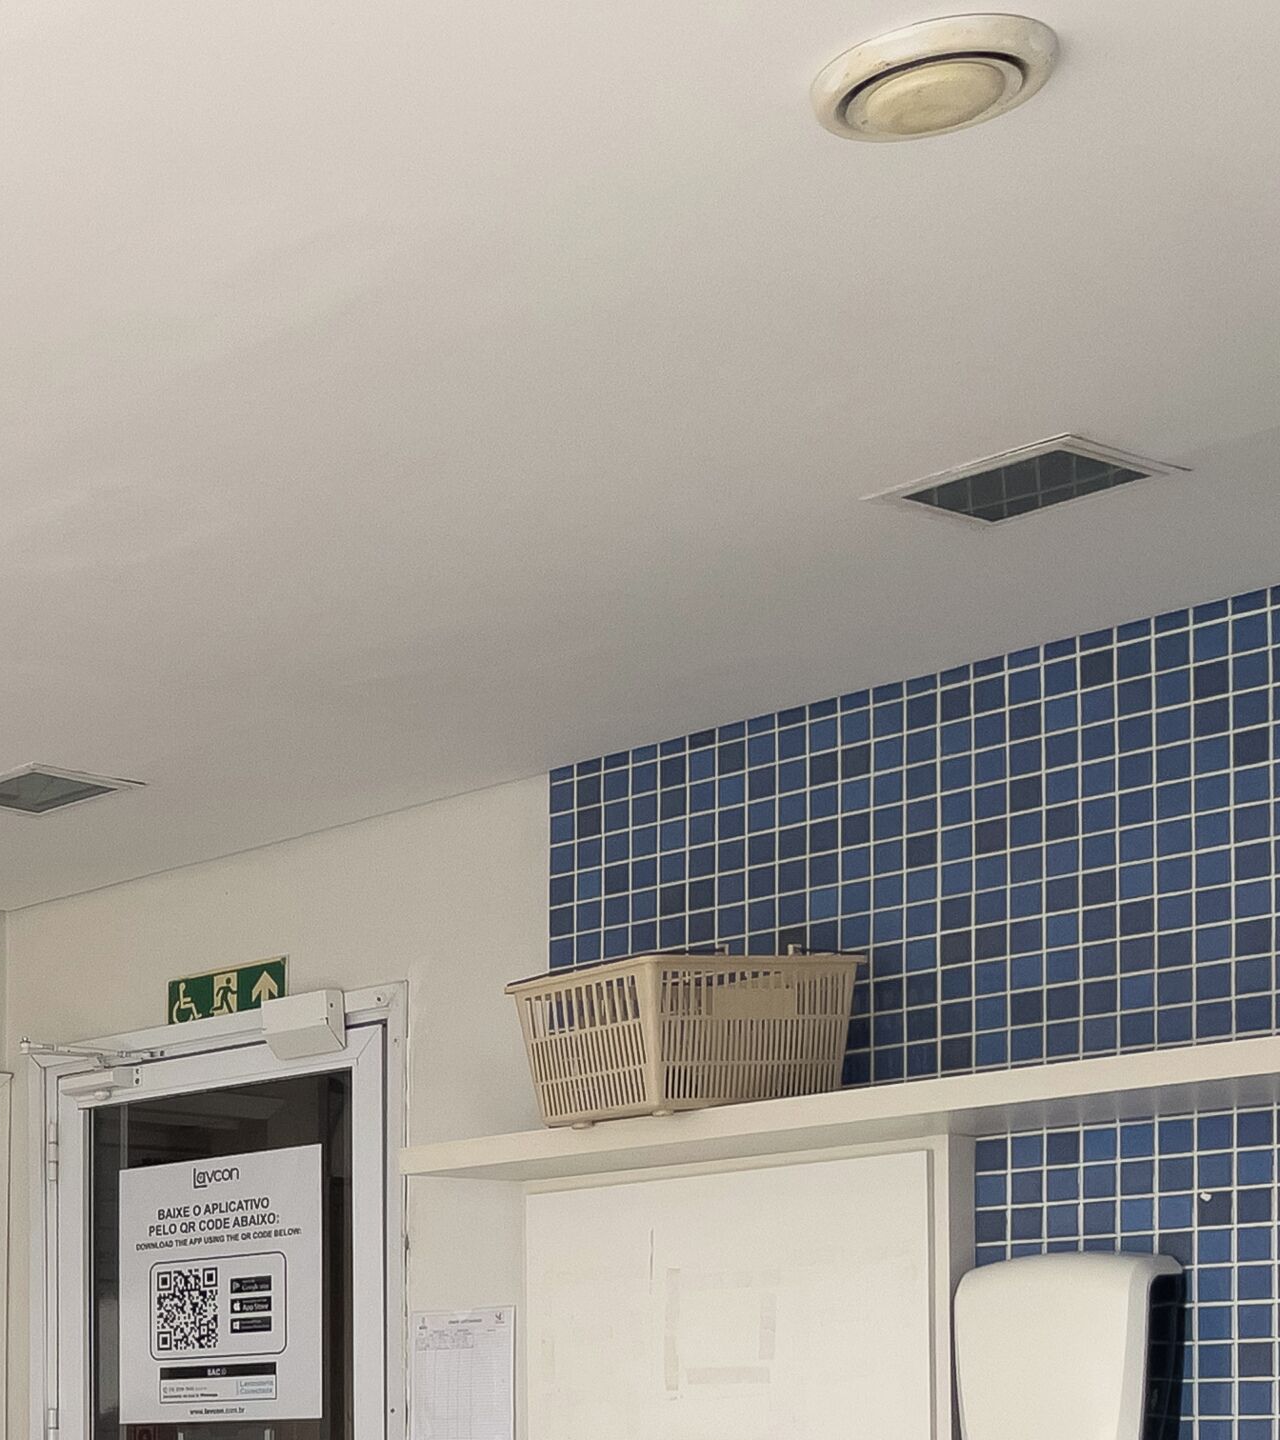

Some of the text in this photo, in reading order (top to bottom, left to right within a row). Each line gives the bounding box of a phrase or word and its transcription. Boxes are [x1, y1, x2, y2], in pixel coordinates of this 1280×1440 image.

[158, 1197, 269, 1220] BAIXE O APLICATIVO
[149, 1213, 280, 1237] PELO QR CODE ABAIXO:
[135, 1239, 174, 1251] DOWNLOAD
[175, 1238, 188, 1247] THE
[190, 1237, 203, 1246] APP
[204, 1234, 225, 1244] USING
[226, 1233, 239, 1242] THE
[241, 1231, 251, 1240] QR
[252, 1230, 272, 1240] CODE
